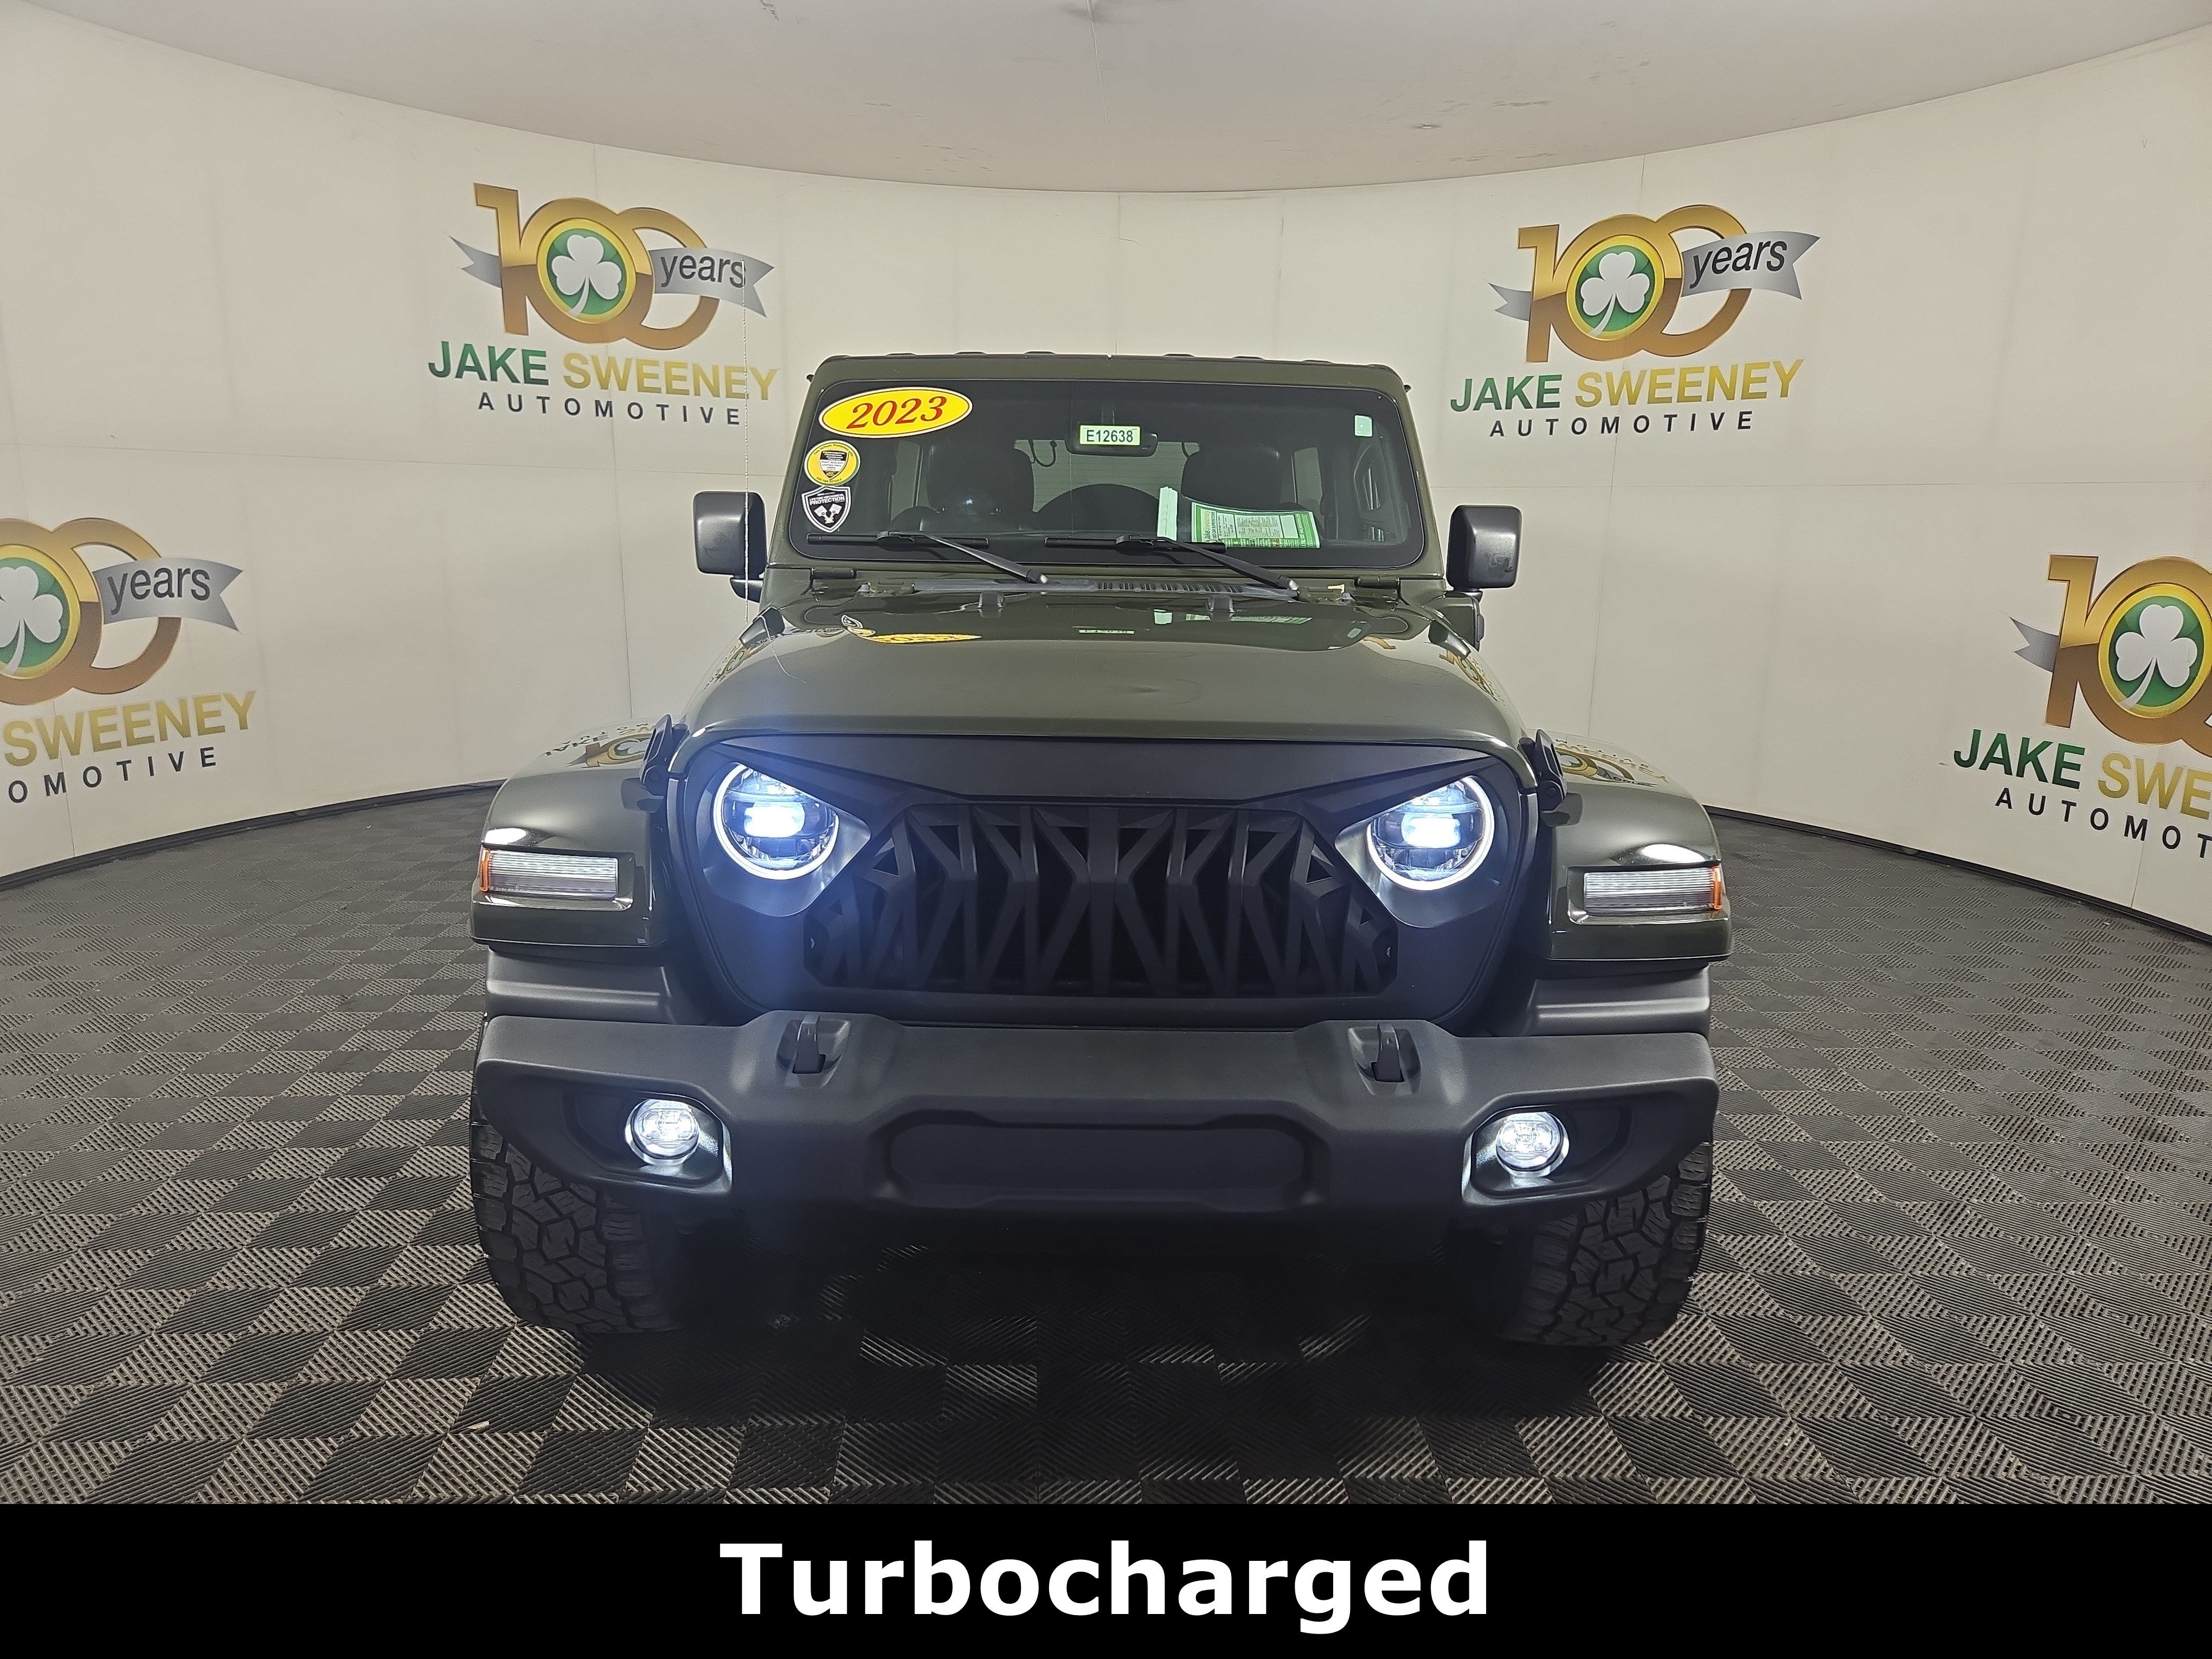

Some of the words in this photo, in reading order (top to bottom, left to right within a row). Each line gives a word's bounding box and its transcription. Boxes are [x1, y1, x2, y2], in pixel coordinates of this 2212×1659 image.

[660, 255, 747, 288] years
[1689, 240, 1787, 289] years
[428, 340, 549, 387] JAKE
[563, 352, 777, 402] SWEENEY
[1451, 374, 1562, 412] JAKE
[1575, 358, 1804, 408] SWEENEY
[478, 392, 740, 426] AUTOMOTIVE
[846, 396, 948, 430] 2023
[1489, 410, 1753, 438] AUTOMOTIVE
[1086, 429, 1133, 442] E12638
[809, 496, 845, 506] PROTECTION
[107, 566, 211, 616] years
[3, 690, 256, 767] SWEENEY
[8, 746, 216, 803] OMOTIVE
[1953, 728, 2086, 790] JAKE
[2098, 752, 2212, 820] SWE
[1995, 787, 2212, 859] AUTOMOT
